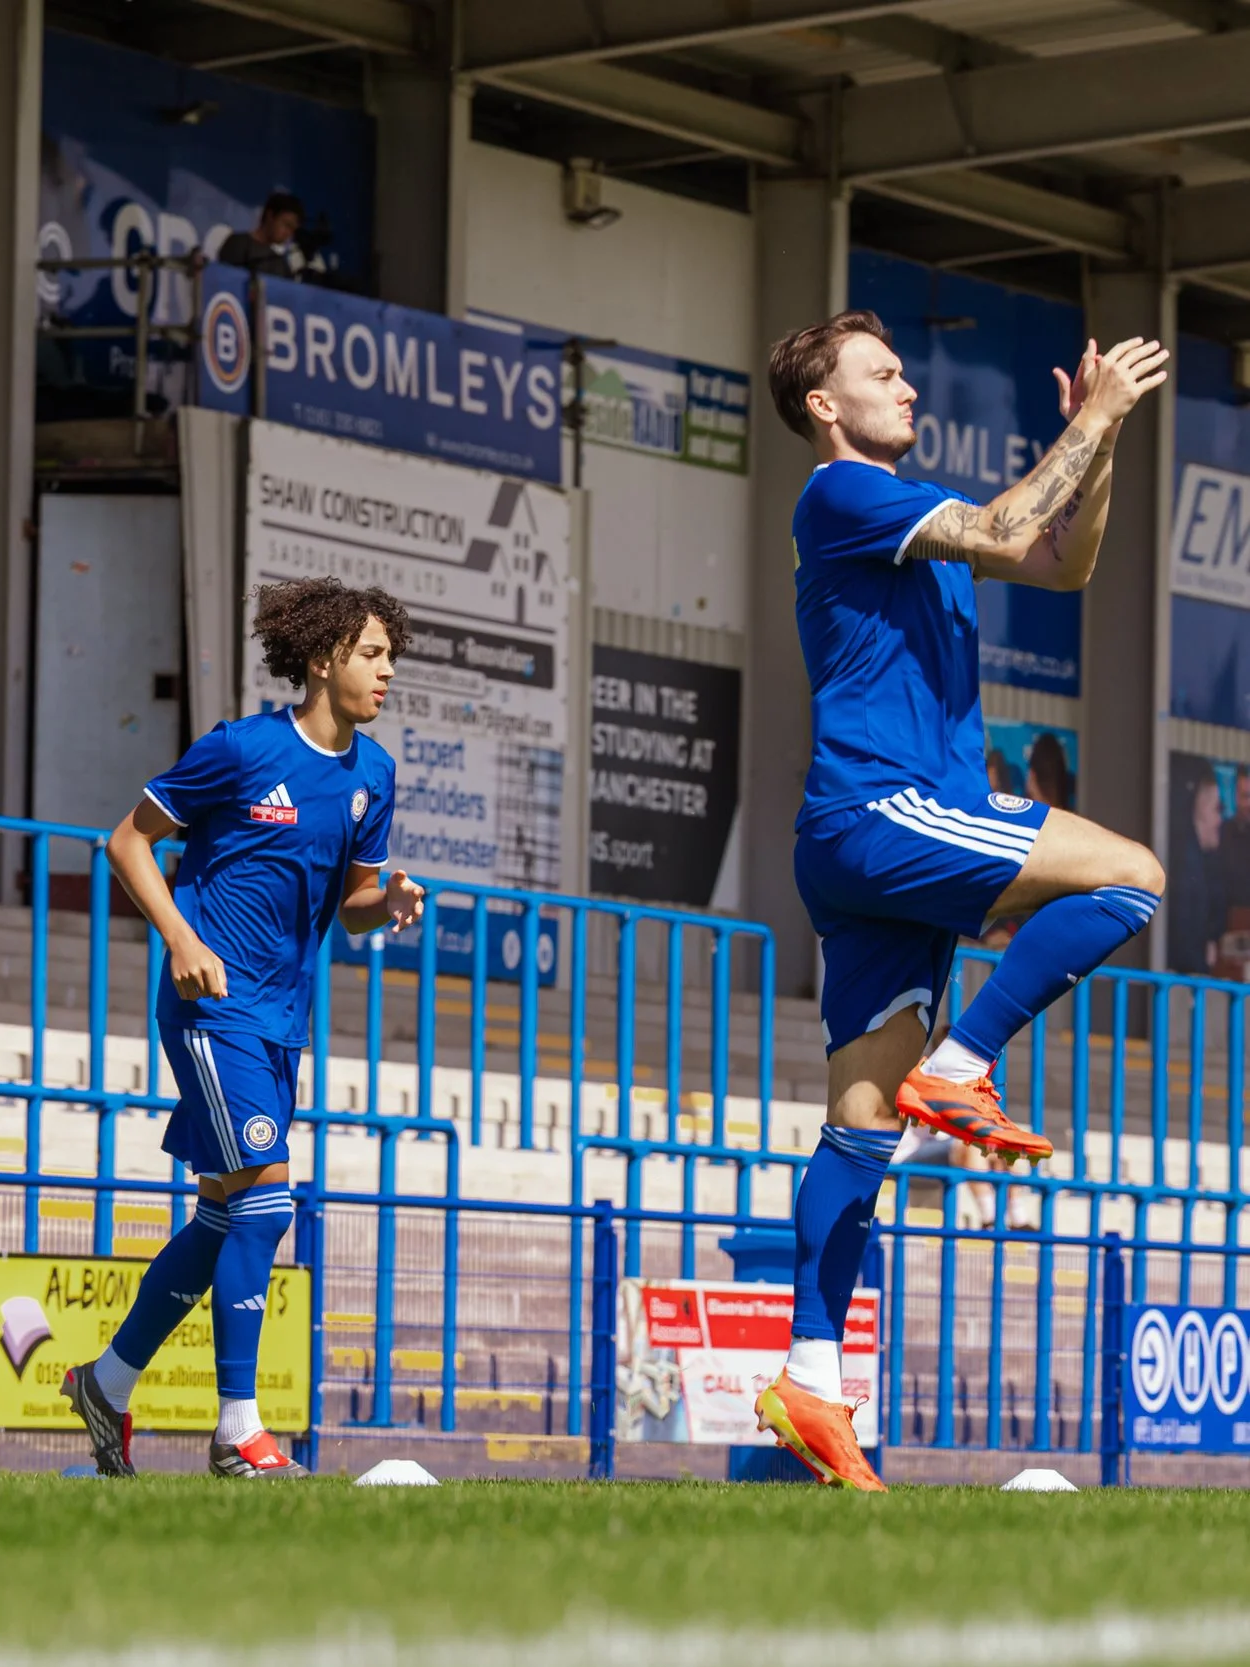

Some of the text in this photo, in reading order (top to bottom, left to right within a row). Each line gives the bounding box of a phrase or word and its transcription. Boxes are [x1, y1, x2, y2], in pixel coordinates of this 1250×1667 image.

[217, 323, 237, 363] B
[265, 306, 558, 430] BROMLEYS
[260, 473, 465, 547] SHAW CONSTRUCTION
[268, 540, 448, 598] SADDLEWORTH LTD
[593, 674, 699, 724] EER IN THE
[403, 727, 466, 775] Expert
[593, 721, 717, 773] STUDYING AT
[395, 776, 486, 822] caffolders
[45, 1265, 132, 1313] ALBION
[703, 1374, 743, 1394] CALL
